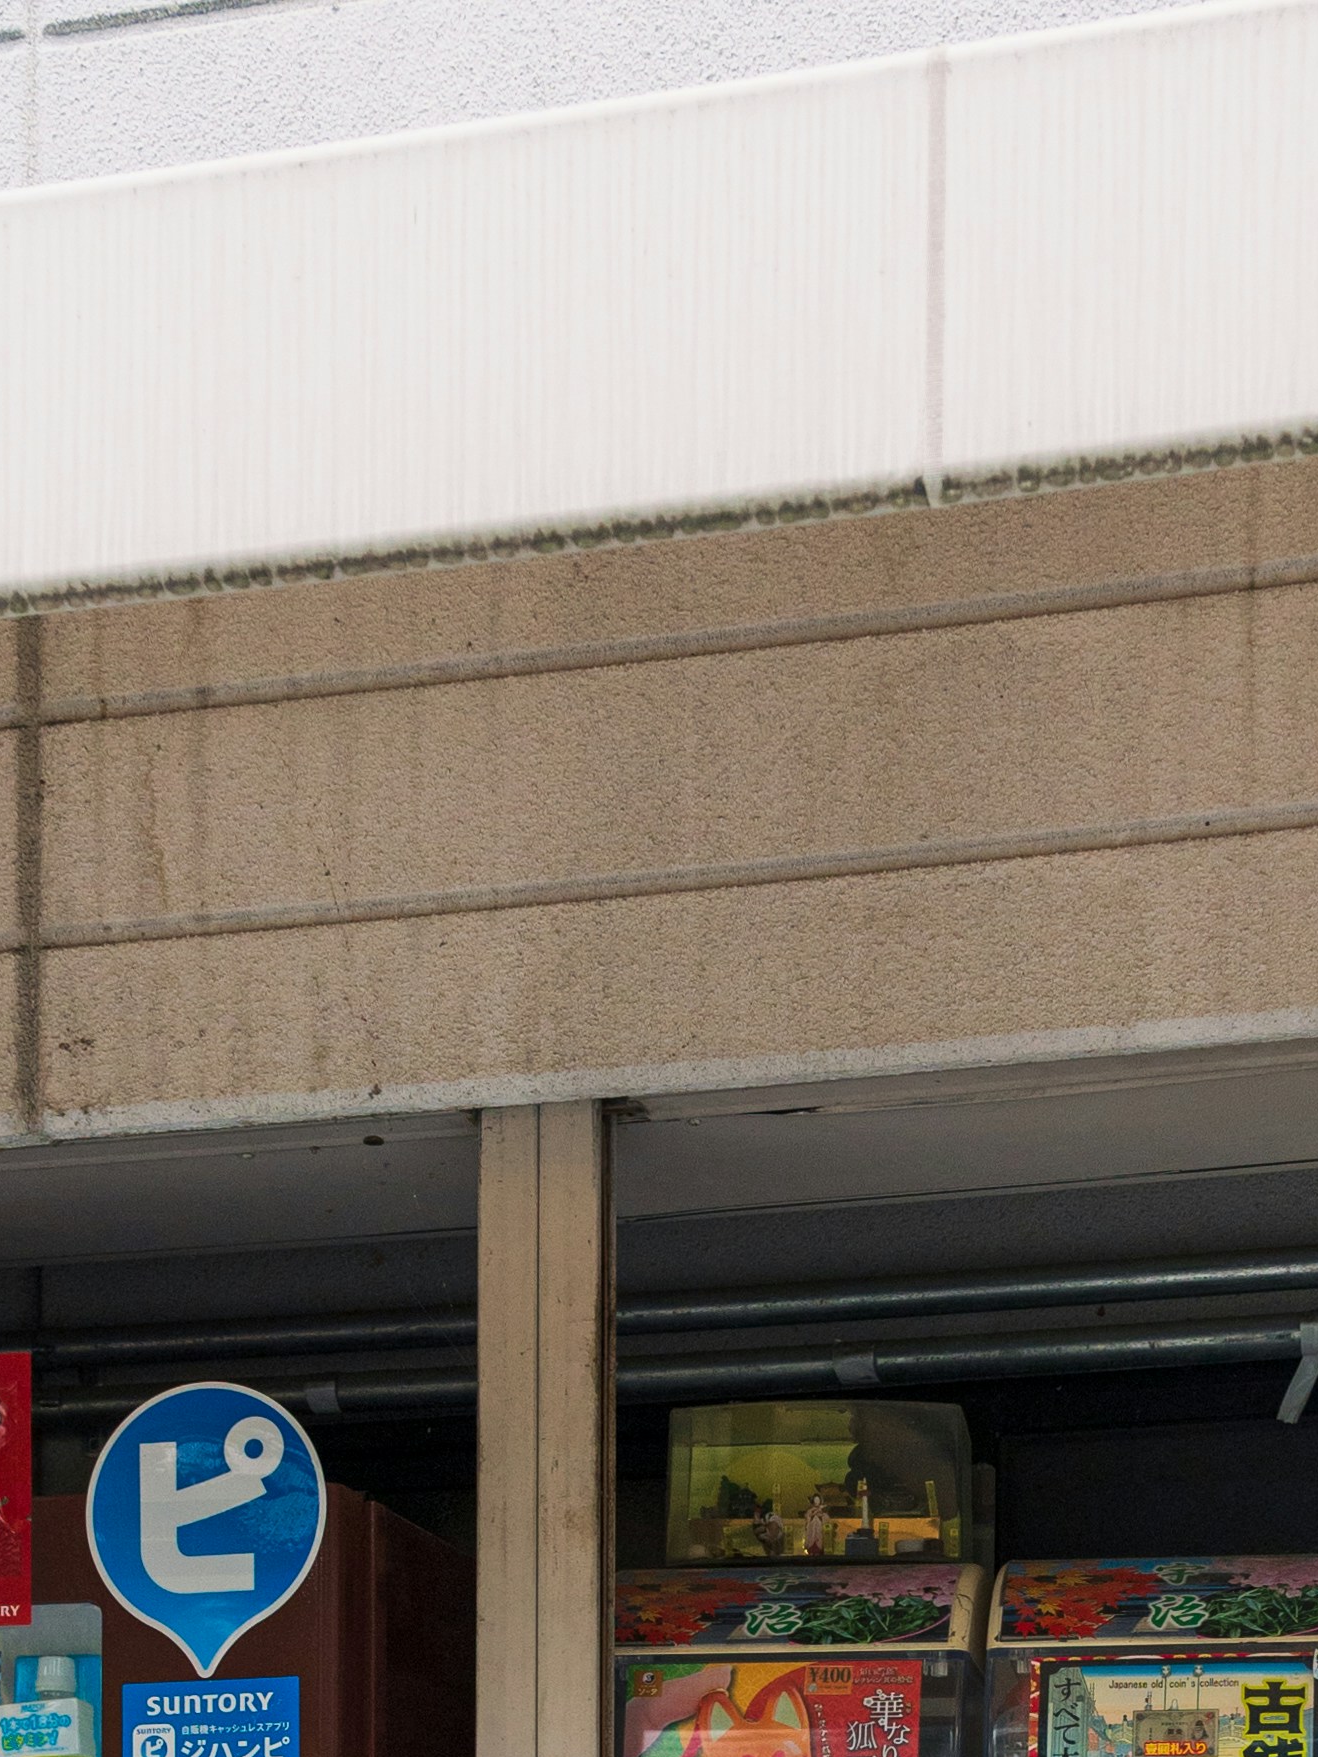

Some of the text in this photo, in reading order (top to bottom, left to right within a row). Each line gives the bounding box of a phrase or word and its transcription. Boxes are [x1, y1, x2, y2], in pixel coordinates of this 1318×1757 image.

[138, 1415, 286, 1595] ピ
[808, 1666, 852, 1685] ¥400
[1108, 1677, 1240, 1690] Japanese old collection
[146, 1691, 274, 1717] SUNTORY
